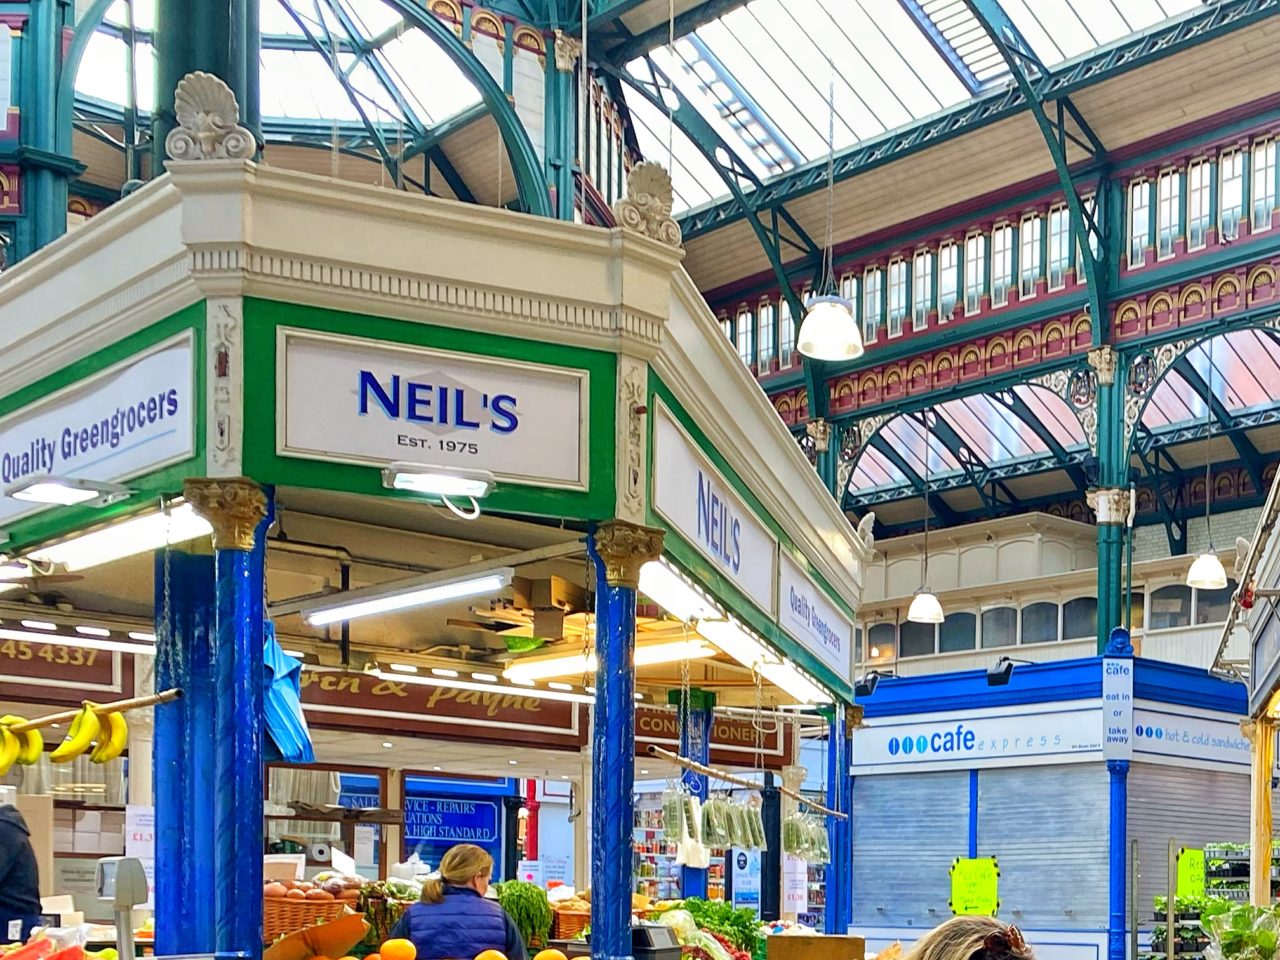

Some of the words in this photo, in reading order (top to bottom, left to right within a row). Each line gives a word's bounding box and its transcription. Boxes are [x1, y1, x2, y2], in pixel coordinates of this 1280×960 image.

[358, 370, 519, 435] NEIL'S
[2, 438, 56, 483] Quality
[61, 389, 178, 460] Greengrocers
[439, 440, 478, 454] 1975
[696, 470, 741, 575] NEIL'S
[790, 585, 811, 627] Quality
[812, 605, 841, 653] Greengrocers
[38, 644, 99, 666] 4337
[1106, 664, 1130, 675] cafe
[1106, 693, 1119, 701] eat
[1122, 693, 1130, 701] in
[1113, 709, 1123, 717] or
[931, 724, 975, 752] cafe
[977, 733, 1061, 752] express
[1108, 727, 1127, 735] take
[1106, 735, 1129, 744] away
[1165, 728, 1179, 742] hot
[1181, 731, 1190, 743] &
[1192, 733, 1209, 746] cold
[1211, 736, 1250, 750] sandwiche
[437, 802, 476, 814] REPAIRS
[413, 825, 437, 837] HIGH
[439, 827, 490, 840] STANDARD
